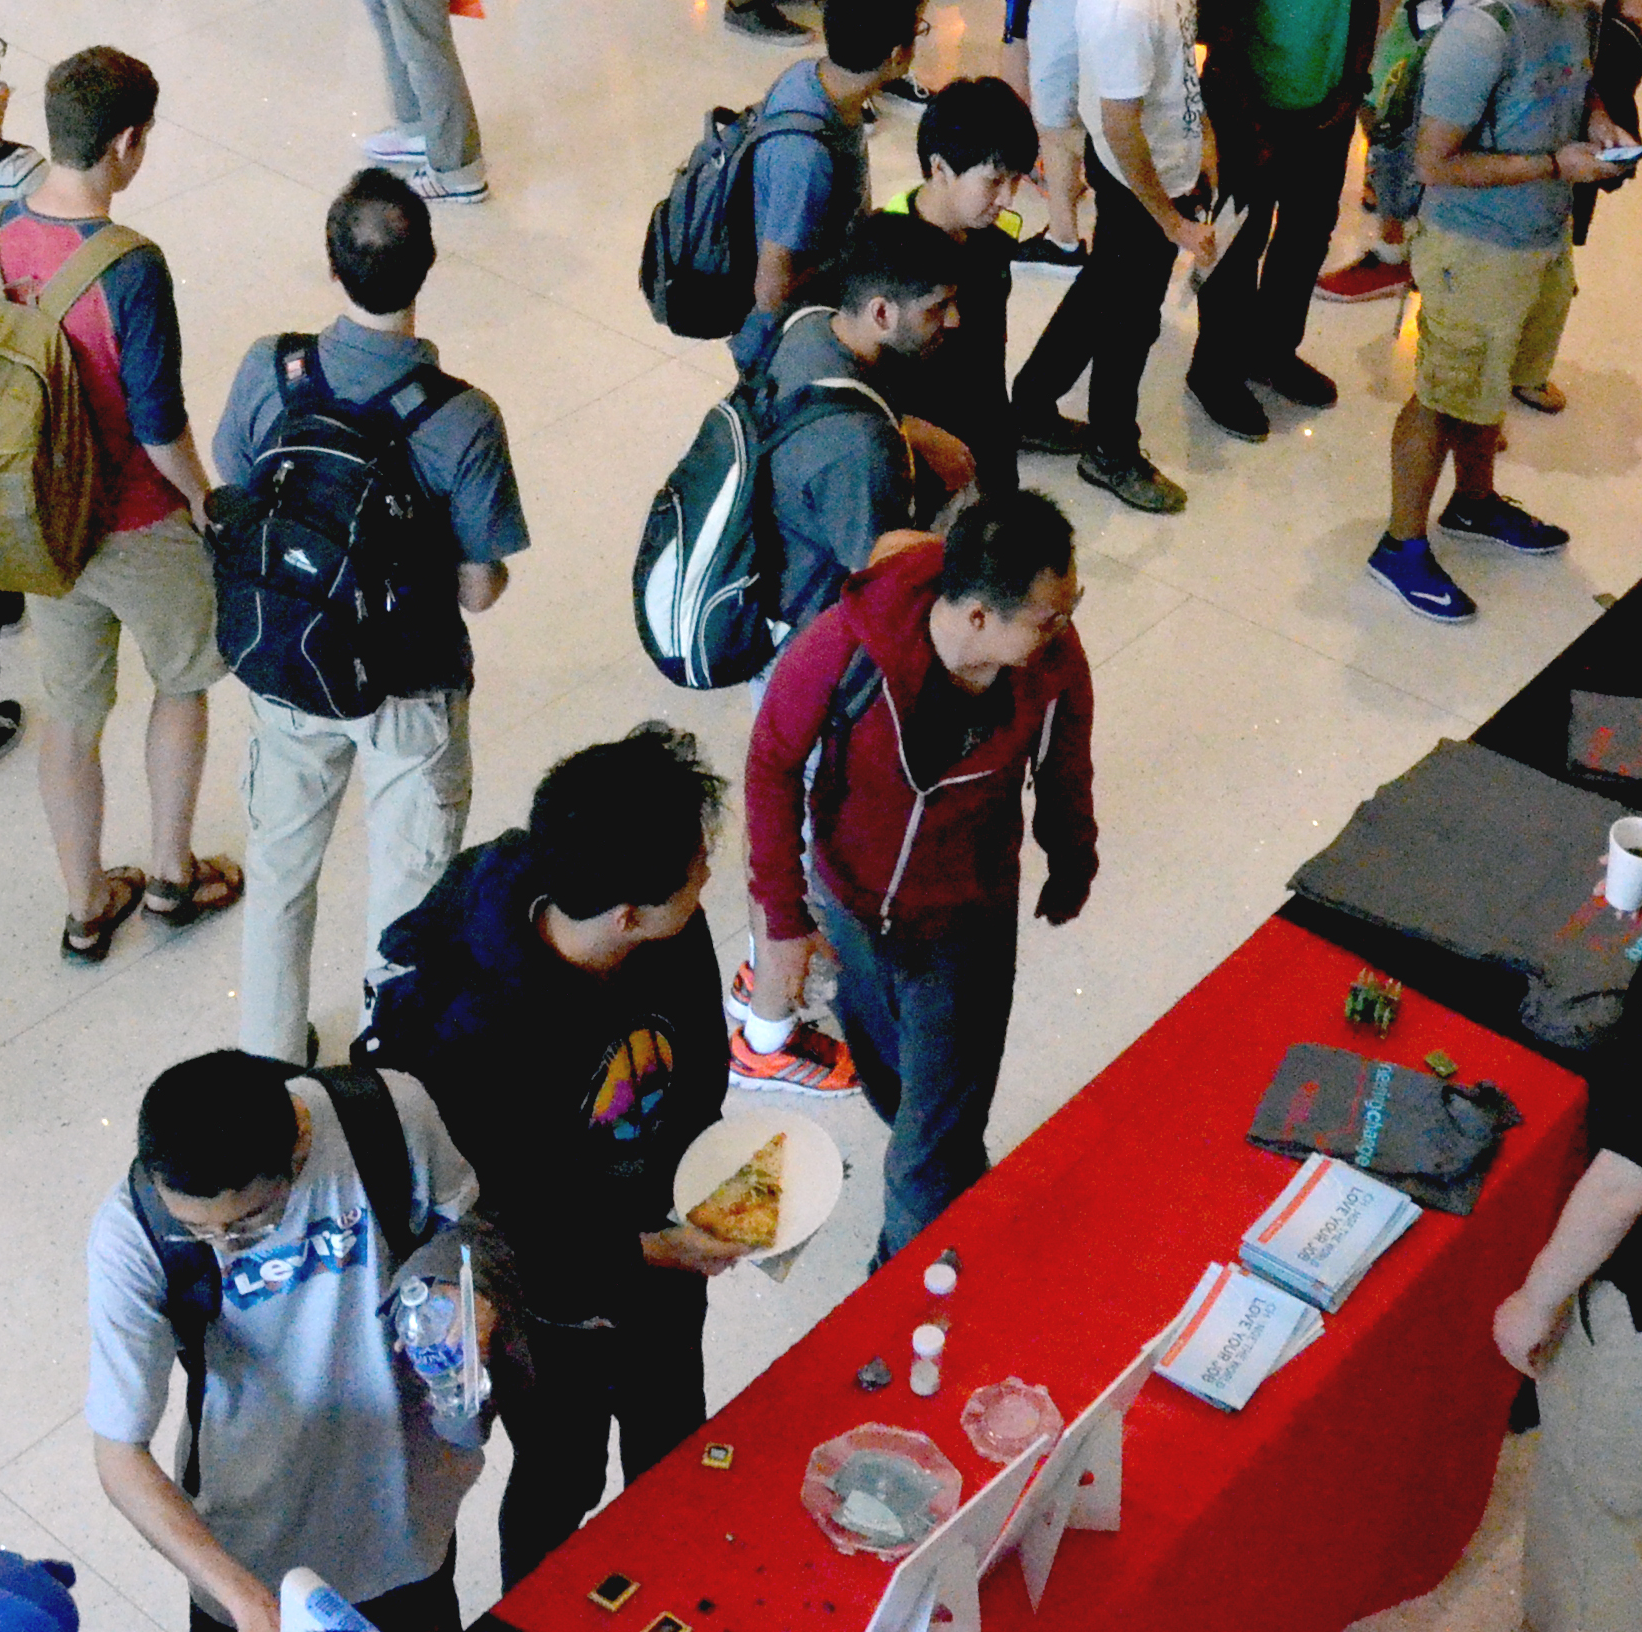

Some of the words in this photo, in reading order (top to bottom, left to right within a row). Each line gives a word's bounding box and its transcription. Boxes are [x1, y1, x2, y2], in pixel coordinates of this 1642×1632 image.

[1335, 1186, 1364, 1217] LOVE
[1313, 1215, 1342, 1244] YOUR
[1238, 1297, 1267, 1331] LOVE
[1217, 1331, 1245, 1362] YOUR
[1201, 1360, 1222, 1384] JOB
